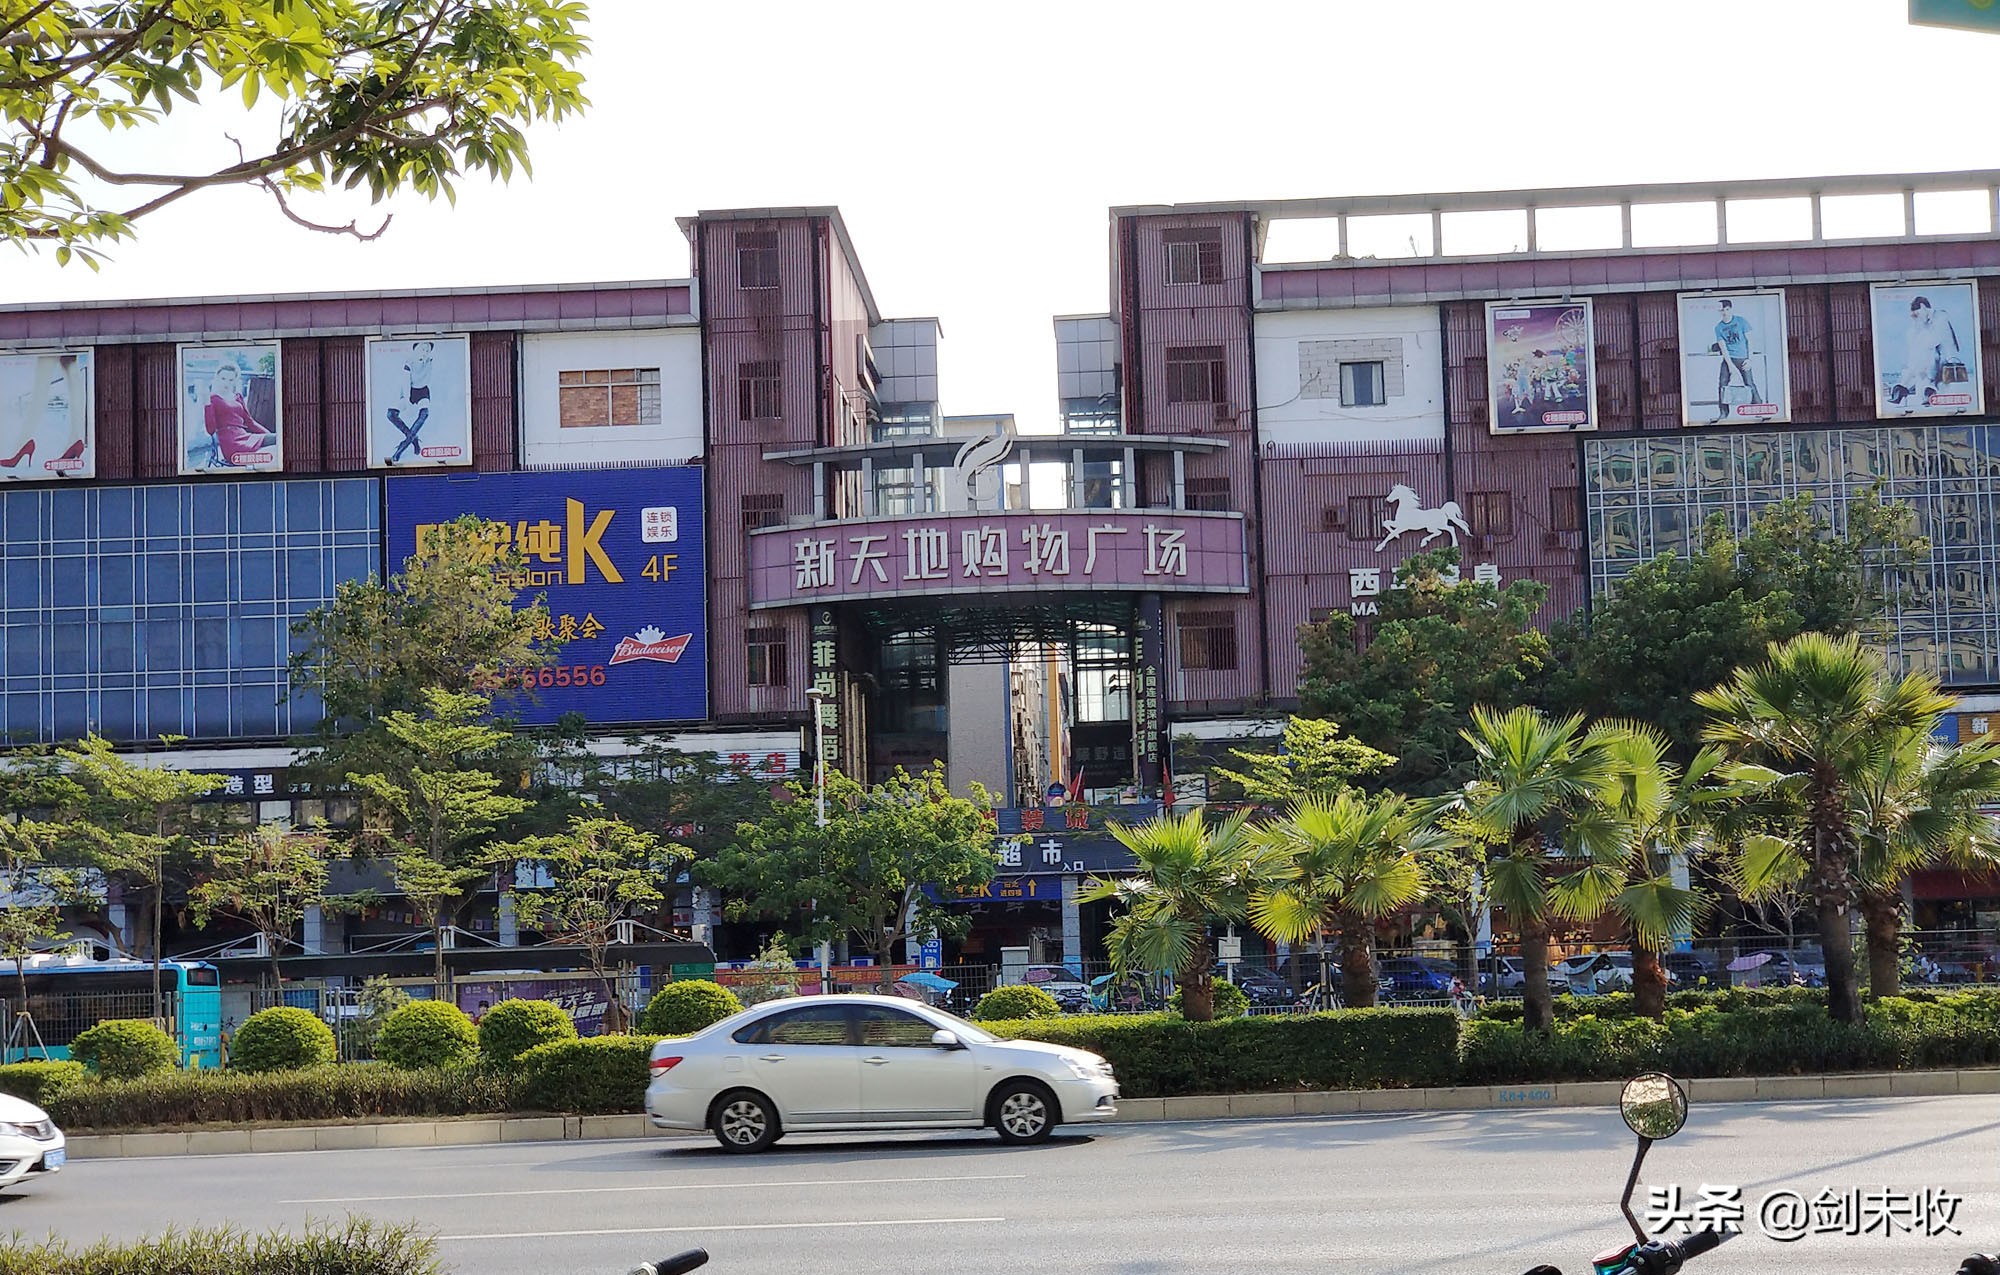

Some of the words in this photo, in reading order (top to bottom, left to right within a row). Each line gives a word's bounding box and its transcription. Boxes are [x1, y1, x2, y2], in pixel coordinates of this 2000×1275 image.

[646, 512, 672, 523] 连锁
[646, 526, 672, 538] 娱乐
[793, 524, 1189, 589] 新天地购物广场
[641, 554, 678, 582] 4F
[618, 641, 684, 657] Budweiser
[1146, 665, 1158, 763] 全国连锁深圳旗舰店
[1971, 717, 1989, 734] 新
[981, 808, 1089, 832] 装城
[998, 839, 1064, 867] 超市
[1063, 861, 1084, 872] 入口
